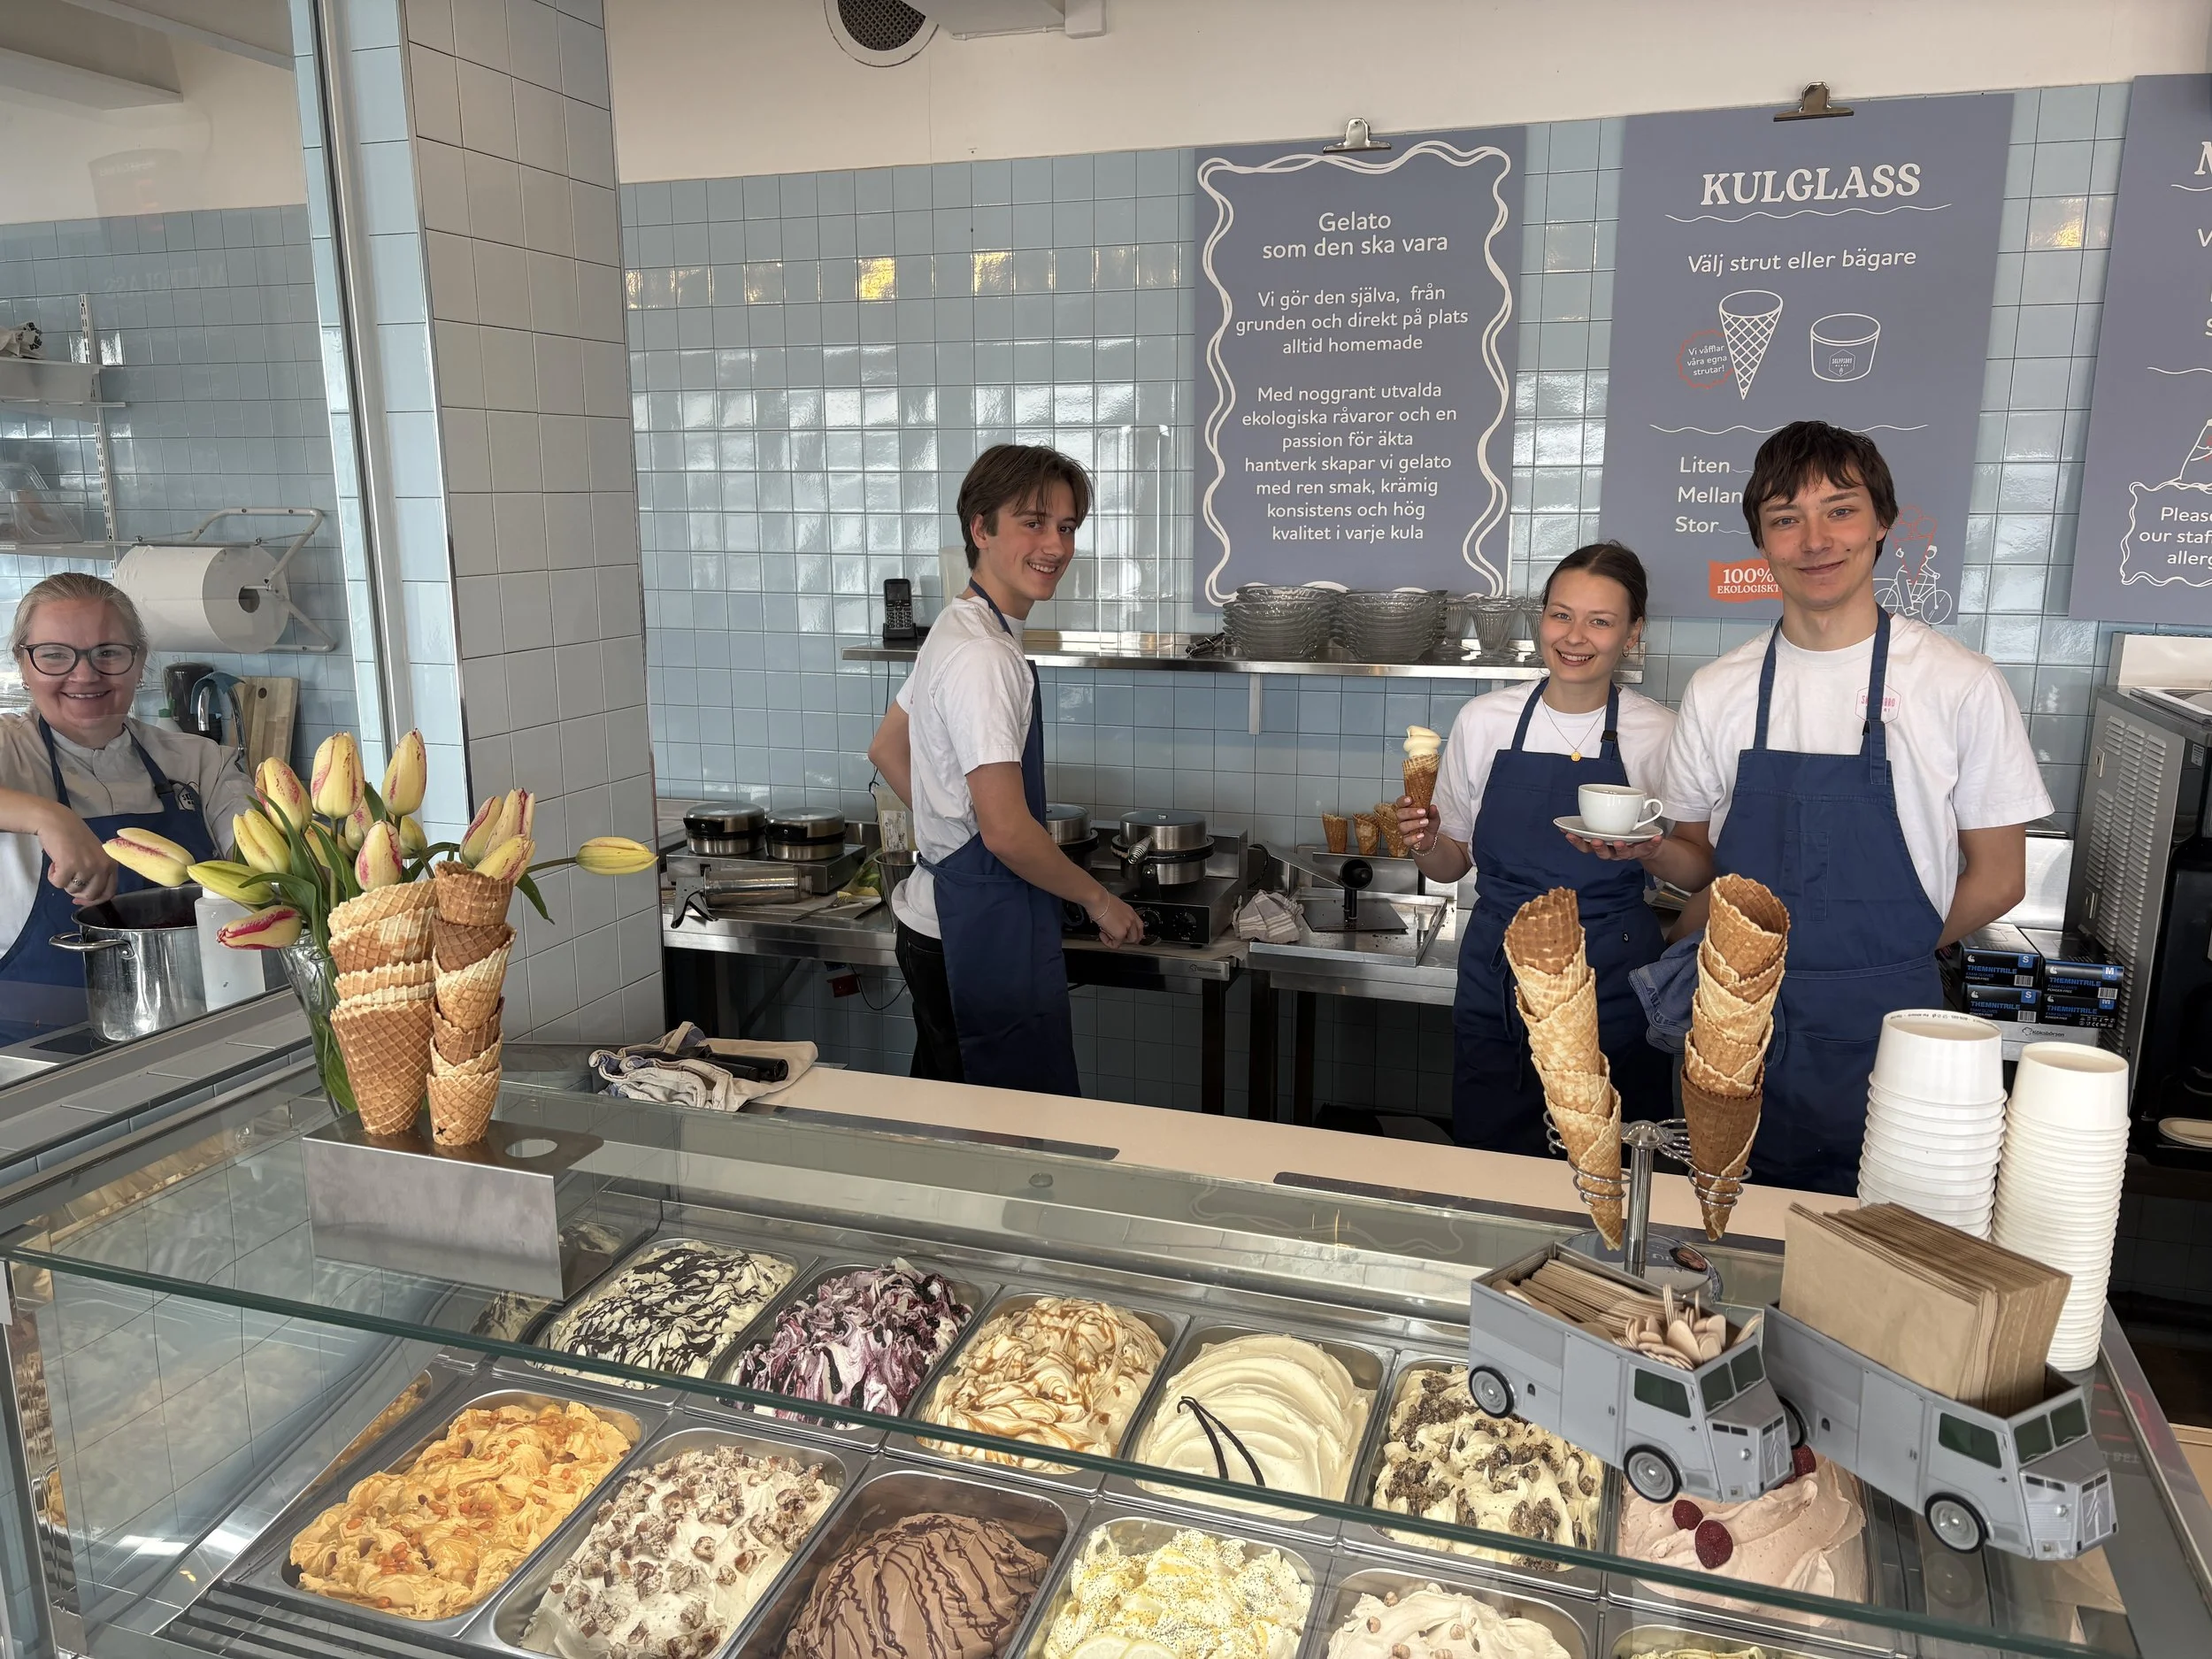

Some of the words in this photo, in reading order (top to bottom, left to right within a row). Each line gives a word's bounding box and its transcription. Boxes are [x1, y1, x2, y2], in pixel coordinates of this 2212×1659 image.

[1700, 163, 1921, 206] KULGLASS
[1318, 211, 1392, 232] Gelato
[1263, 243, 1307, 259] som
[1314, 236, 1354, 257] den
[1361, 234, 1395, 255] ska
[1402, 236, 1448, 252] vara
[1687, 253, 1724, 278] Välj
[1730, 254, 1782, 272] strut
[1787, 250, 1836, 270] eller
[1842, 247, 1916, 272] bägare
[1257, 290, 1275, 307] Vi
[1279, 289, 1310, 311] gör
[1314, 289, 1345, 305] den
[1350, 286, 1400, 308] själva,
[1409, 282, 1446, 301] från
[1235, 315, 1306, 336] grunden
[1311, 312, 1342, 329] och
[1348, 311, 1398, 327] direkt
[1402, 307, 1422, 330] på
[1428, 308, 1469, 329] plats
[1282, 337, 1323, 354] alltid
[1328, 334, 1423, 353] homemade
[1688, 347, 1697, 356] Vi
[1686, 357, 1705, 366] våra
[1707, 356, 1727, 365] egna
[1693, 365, 1724, 376] strutar!
[1257, 386, 1293, 403] Med
[1298, 386, 1377, 405] noggrant
[1381, 381, 1441, 398] utvalda
[1241, 409, 1327, 429] ekologiska
[1333, 406, 1394, 424] råvaror
[1399, 405, 1430, 422] och
[1435, 410, 1457, 421] en
[1282, 431, 1343, 453] passion
[1348, 430, 1374, 447] för
[1378, 430, 1413, 446] äkta
[1245, 456, 1317, 472] hantverk
[1321, 455, 1376, 475] skapar
[1379, 453, 1394, 470] vi
[1398, 453, 1452, 474] gelato
[1679, 456, 1730, 473] Liten
[1256, 480, 1291, 495] med
[1296, 483, 1324, 495] ren
[1328, 478, 1376, 495] smak,
[1380, 476, 1438, 497] krämig
[1678, 486, 1743, 503] Mellan
[1267, 503, 1352, 518] konsistens
[1356, 501, 1387, 517] och
[1393, 500, 1425, 520] hög
[1272, 525, 1332, 541] kvalitet
[1336, 524, 1340, 541] i
[1345, 524, 1386, 544] varje
[1390, 524, 1424, 540] kula
[1675, 516, 1719, 534] Stor
[2139, 532, 2172, 542] our
[2177, 530, 2212, 544] staf
[1723, 567, 1775, 584] 100%
[1717, 584, 1779, 595] EKOLOGISKT
[2022, 955, 2030, 964] S
[2105, 966, 2115, 975] M
[2024, 990, 2032, 999] S
